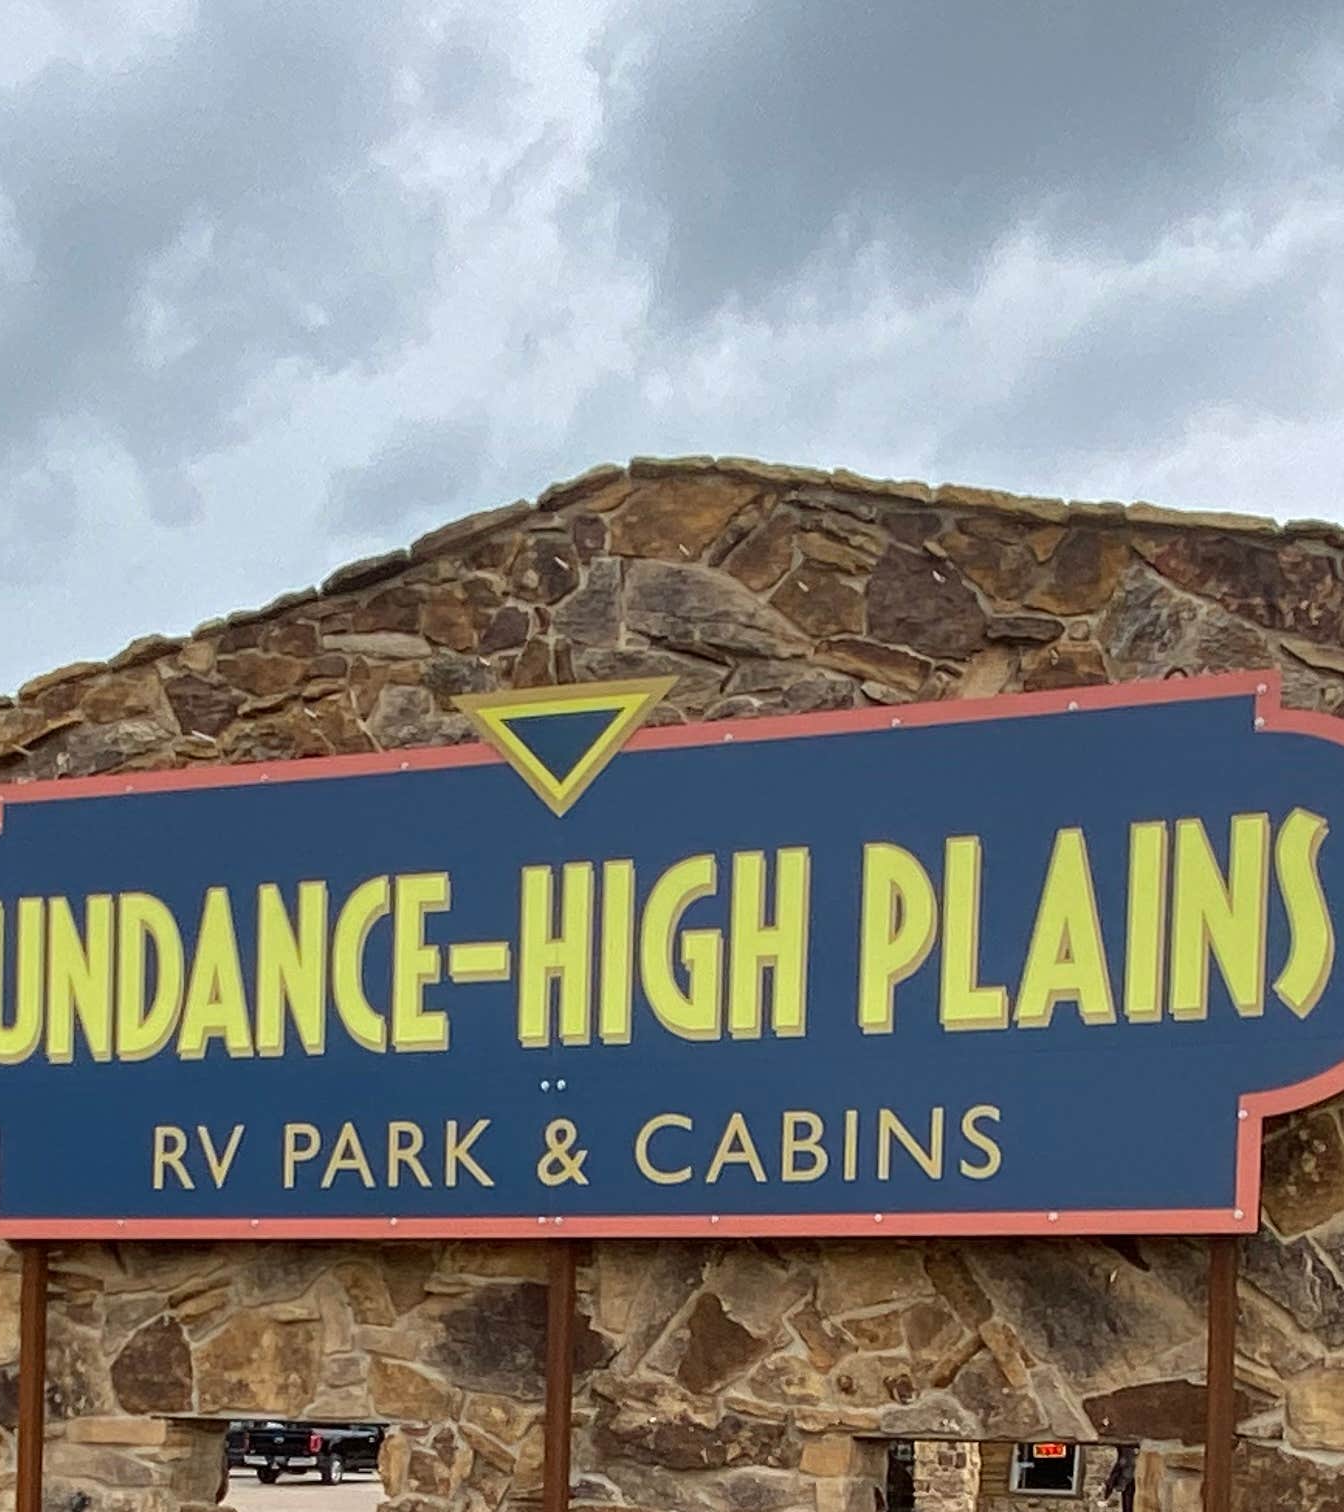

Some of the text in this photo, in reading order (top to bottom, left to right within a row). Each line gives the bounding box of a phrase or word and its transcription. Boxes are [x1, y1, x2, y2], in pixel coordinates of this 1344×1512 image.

[858, 808, 1335, 1032] PLAINS
[152, 1105, 1002, 1190] RV PARK & CABINS
